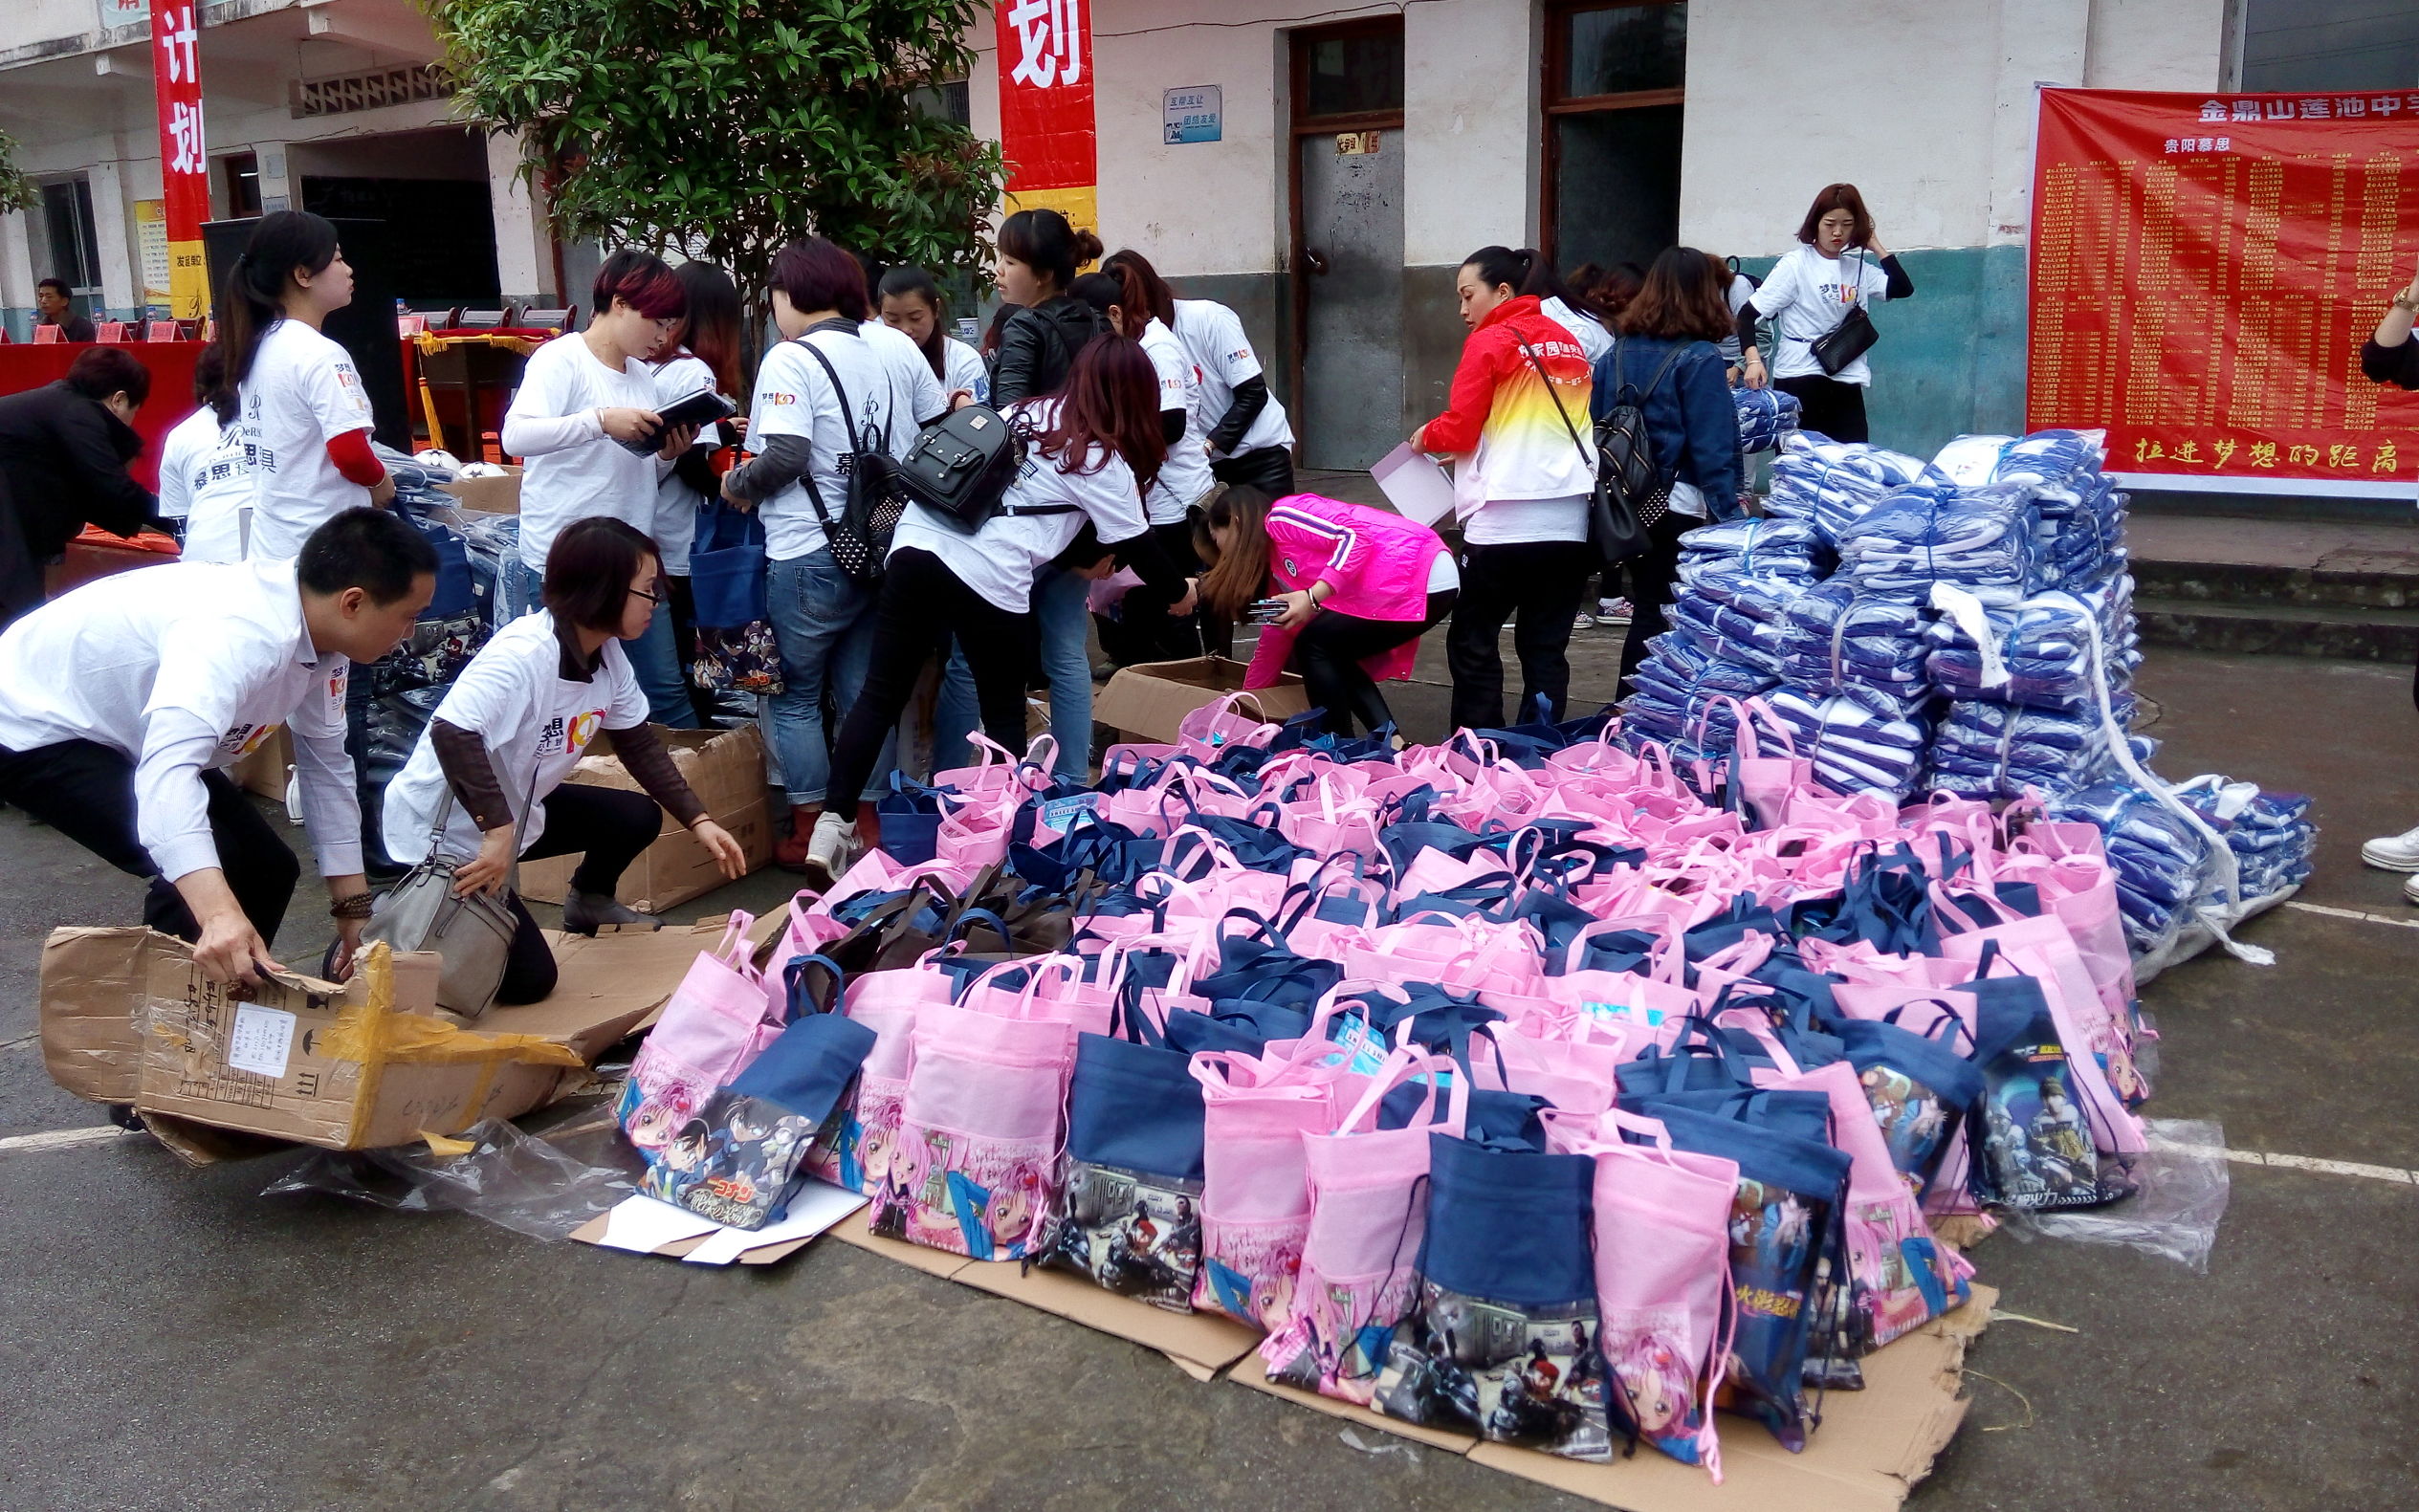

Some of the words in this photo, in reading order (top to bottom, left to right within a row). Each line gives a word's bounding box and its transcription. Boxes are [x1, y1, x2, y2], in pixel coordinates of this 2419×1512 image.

[163, 6, 207, 175] 计划
[2164, 137, 2231, 154] 贵阳慕思
